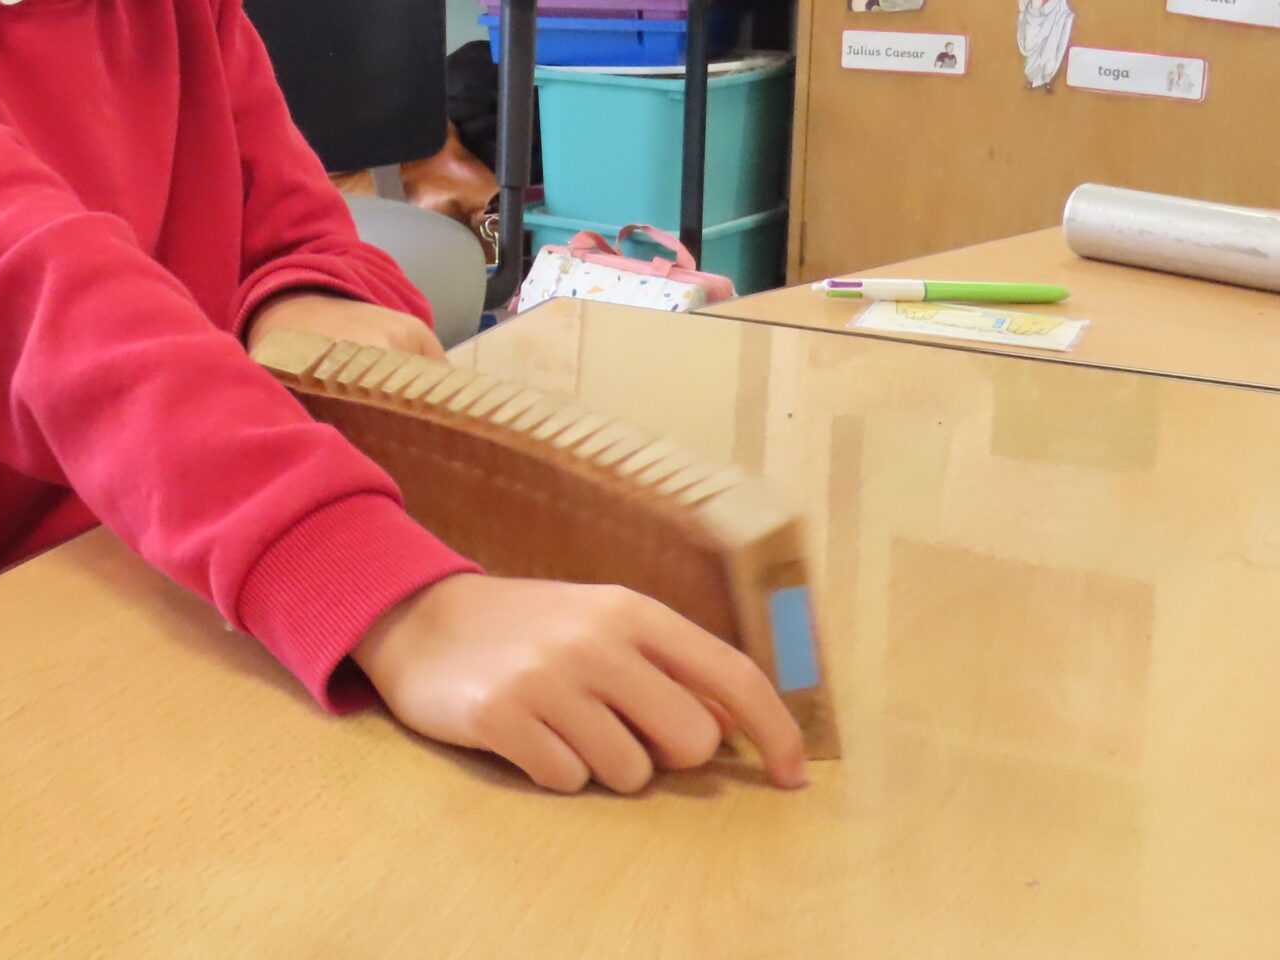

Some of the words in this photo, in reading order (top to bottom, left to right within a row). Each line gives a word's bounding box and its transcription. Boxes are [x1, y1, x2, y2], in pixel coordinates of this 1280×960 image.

[846, 44, 881, 59] Julius
[884, 46, 926, 60] Caesar
[1097, 64, 1130, 80] toga
